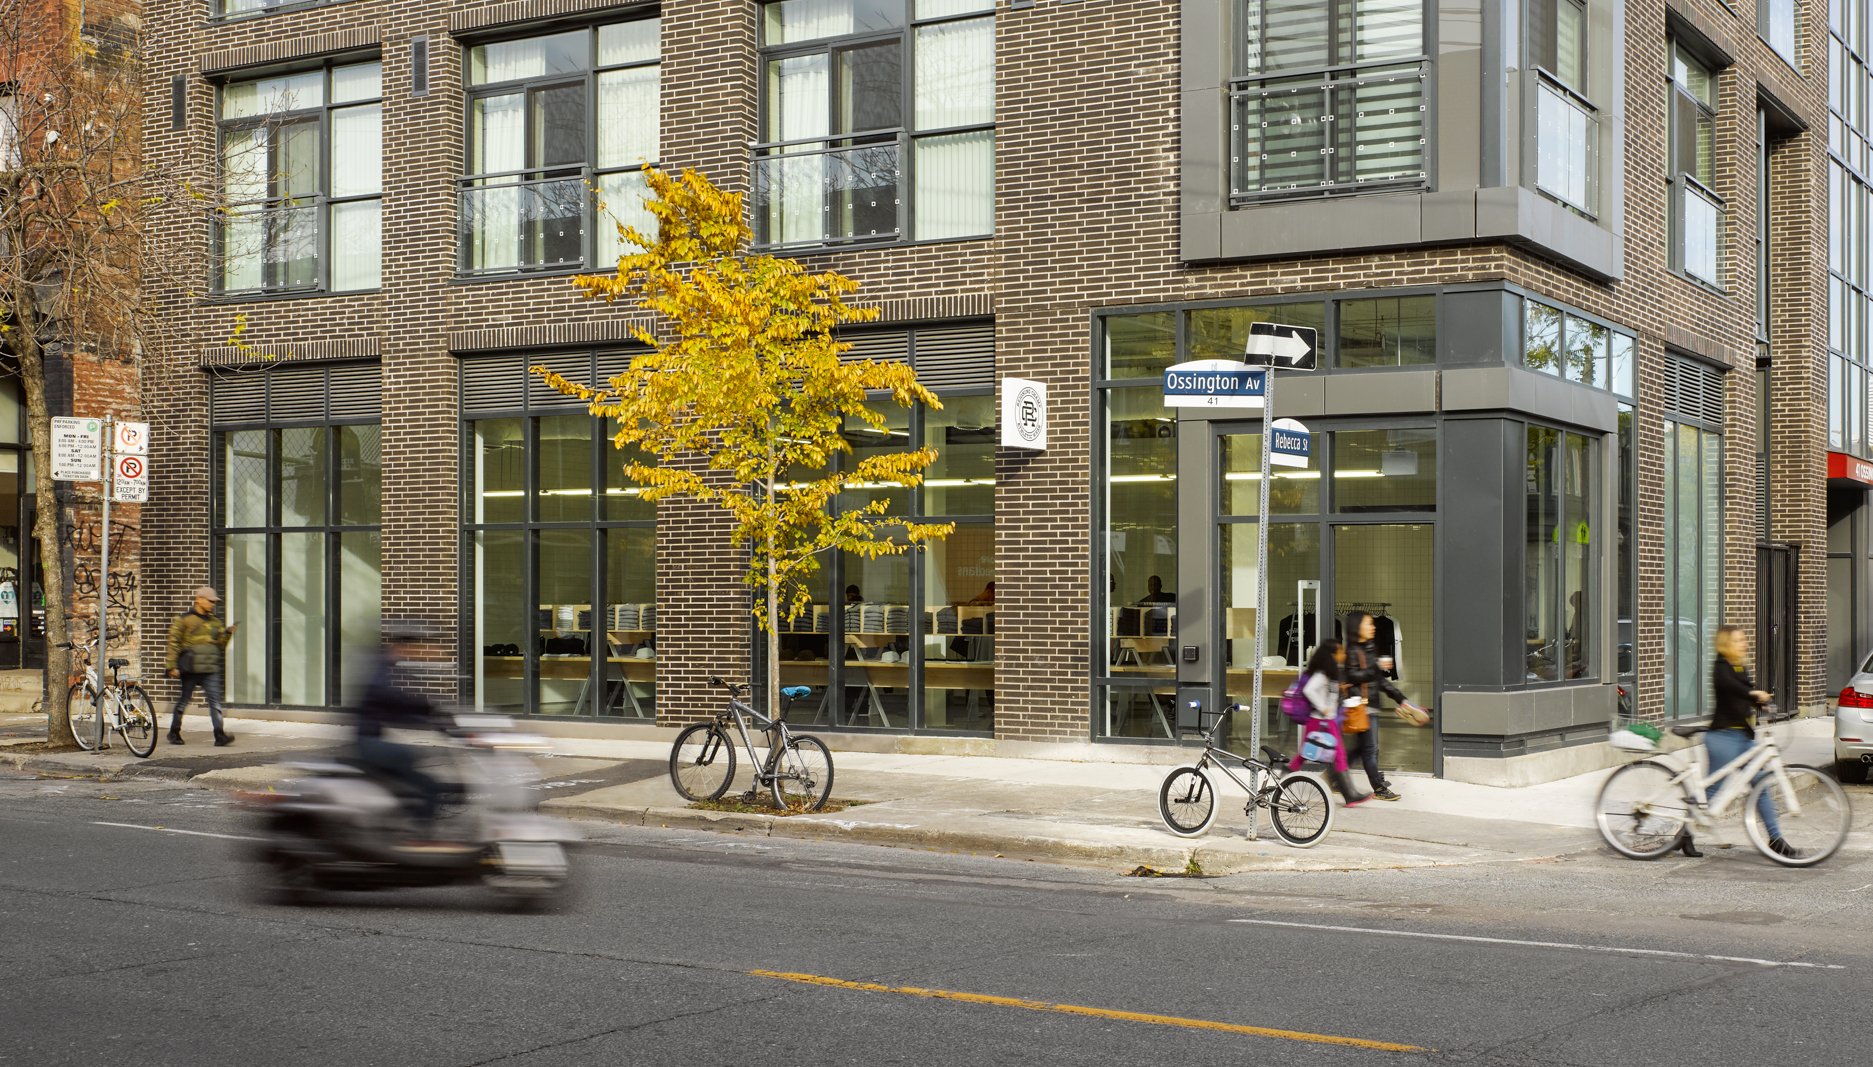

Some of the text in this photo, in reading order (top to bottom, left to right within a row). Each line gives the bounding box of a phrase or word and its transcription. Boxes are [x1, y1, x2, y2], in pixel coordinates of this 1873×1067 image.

[1167, 373, 1260, 393] Ossington Av
[1207, 397, 1218, 405] 41
[1275, 432, 1308, 451] Rebecca St
